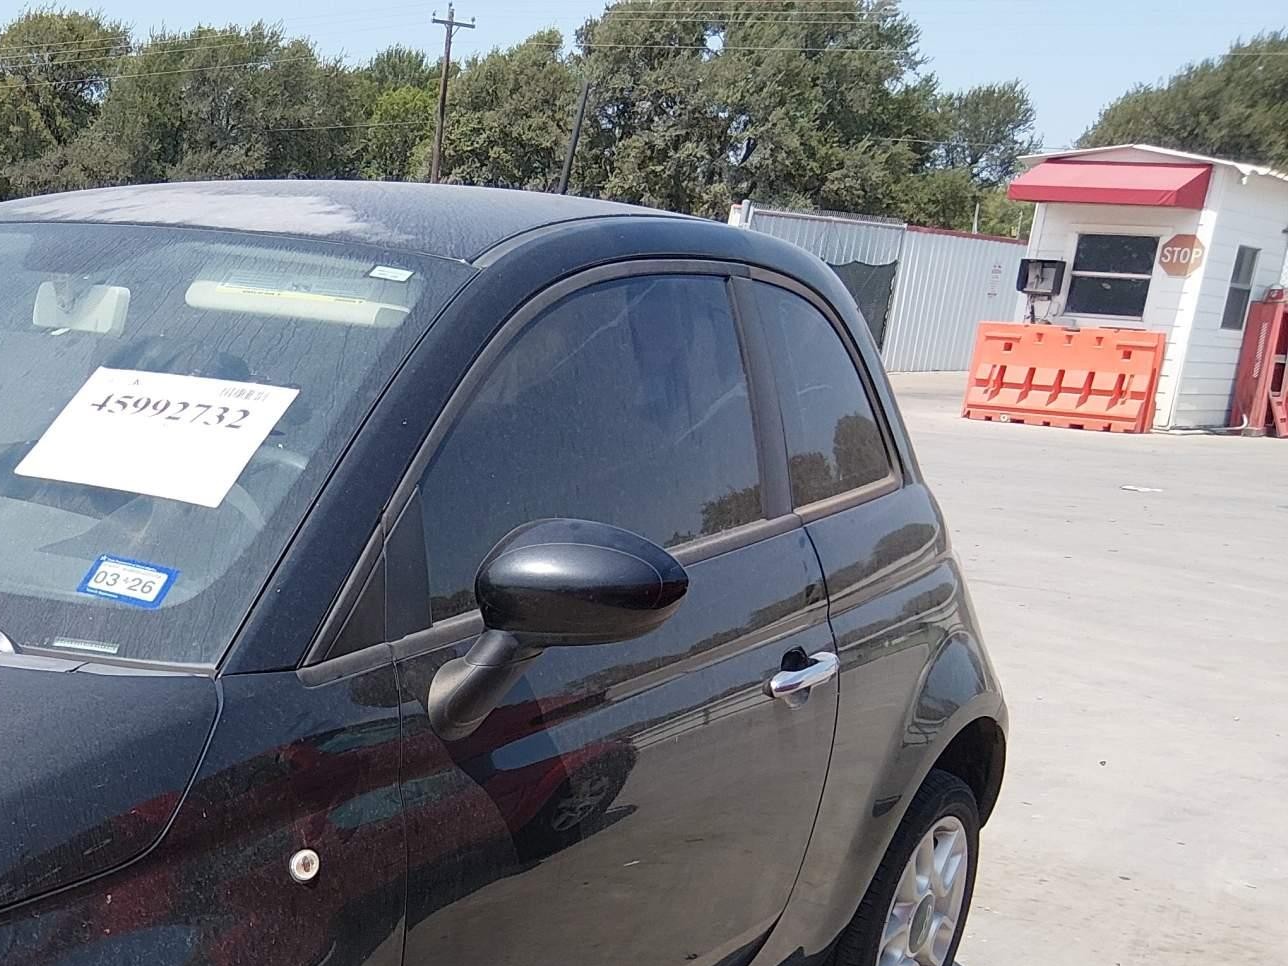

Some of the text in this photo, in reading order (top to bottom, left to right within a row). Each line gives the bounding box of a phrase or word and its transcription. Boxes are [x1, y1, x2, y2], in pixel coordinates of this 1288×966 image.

[1160, 246, 1203, 264] STOP
[90, 393, 251, 430] 45992732
[93, 570, 121, 587] 03
[126, 577, 156, 594] 26
